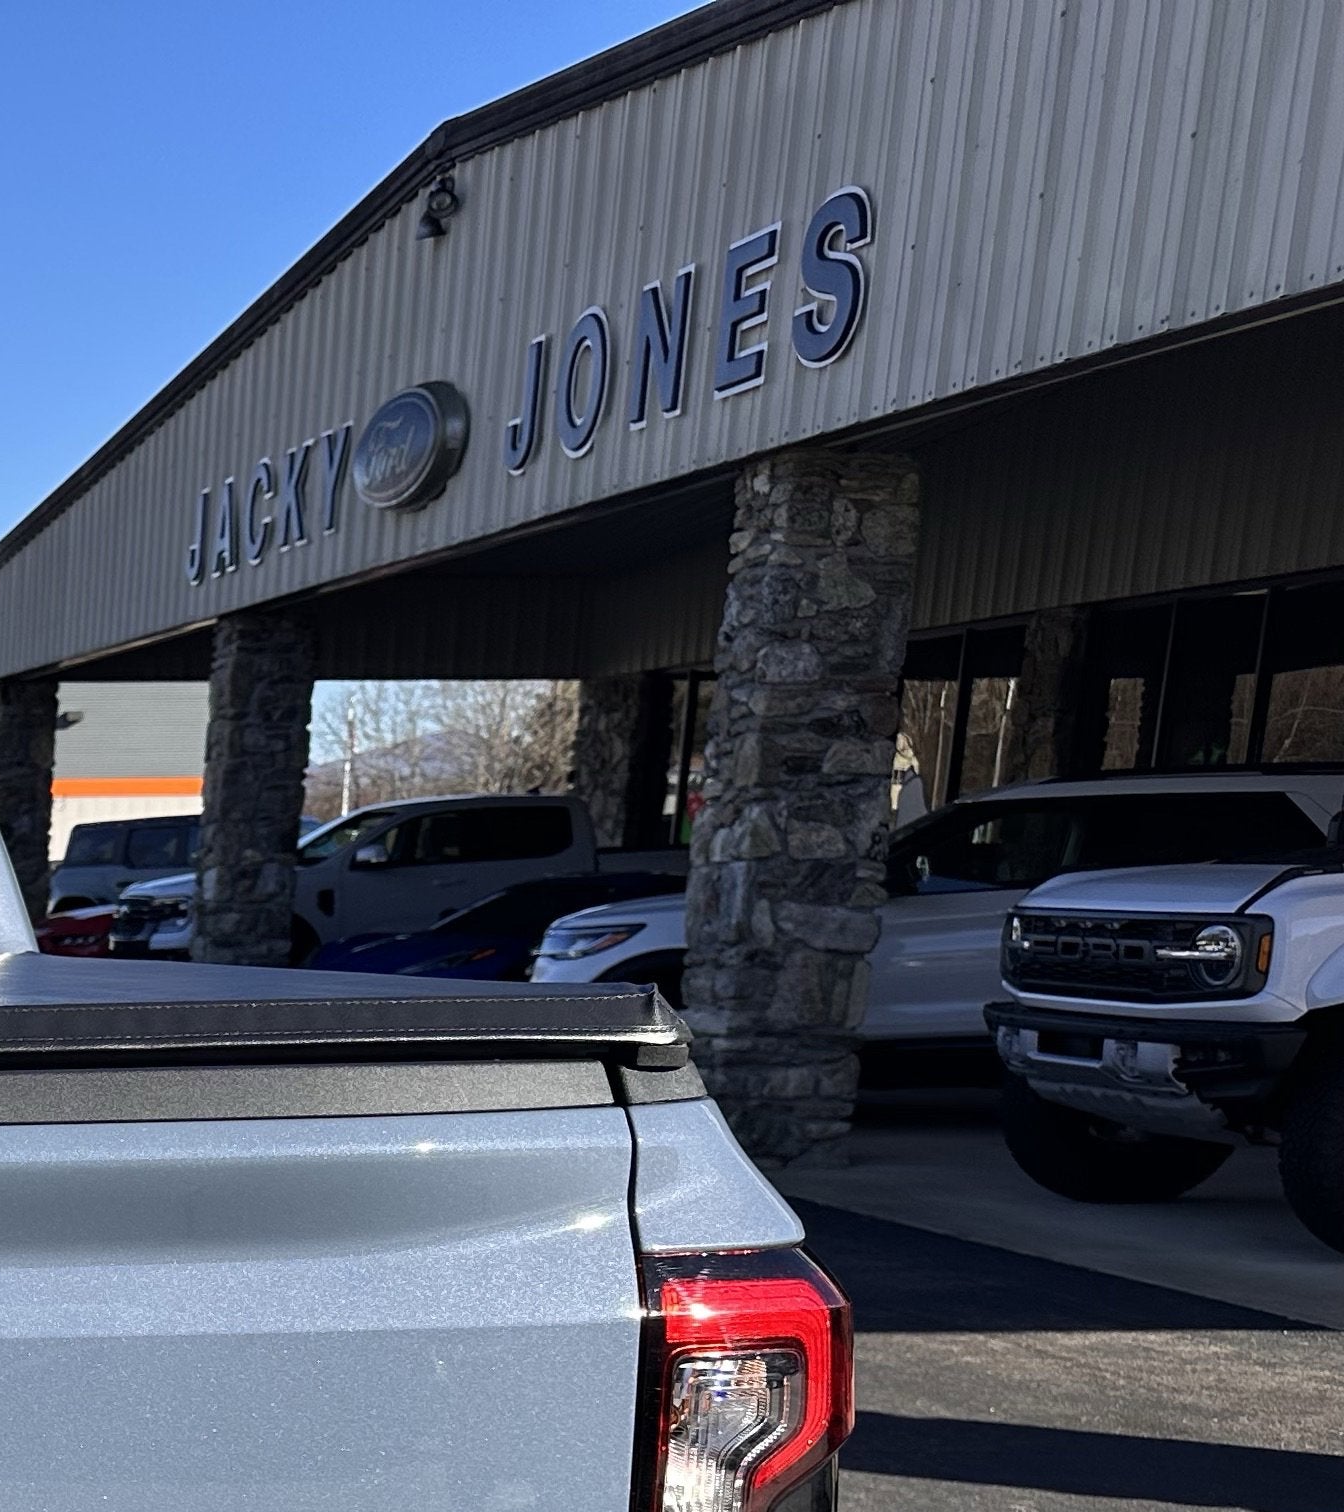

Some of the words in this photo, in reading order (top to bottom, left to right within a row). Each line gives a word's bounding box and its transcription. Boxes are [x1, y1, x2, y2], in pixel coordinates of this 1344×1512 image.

[185, 419, 354, 586] JACKY
[505, 184, 873, 476] JONES
[363, 415, 416, 486] Ford
